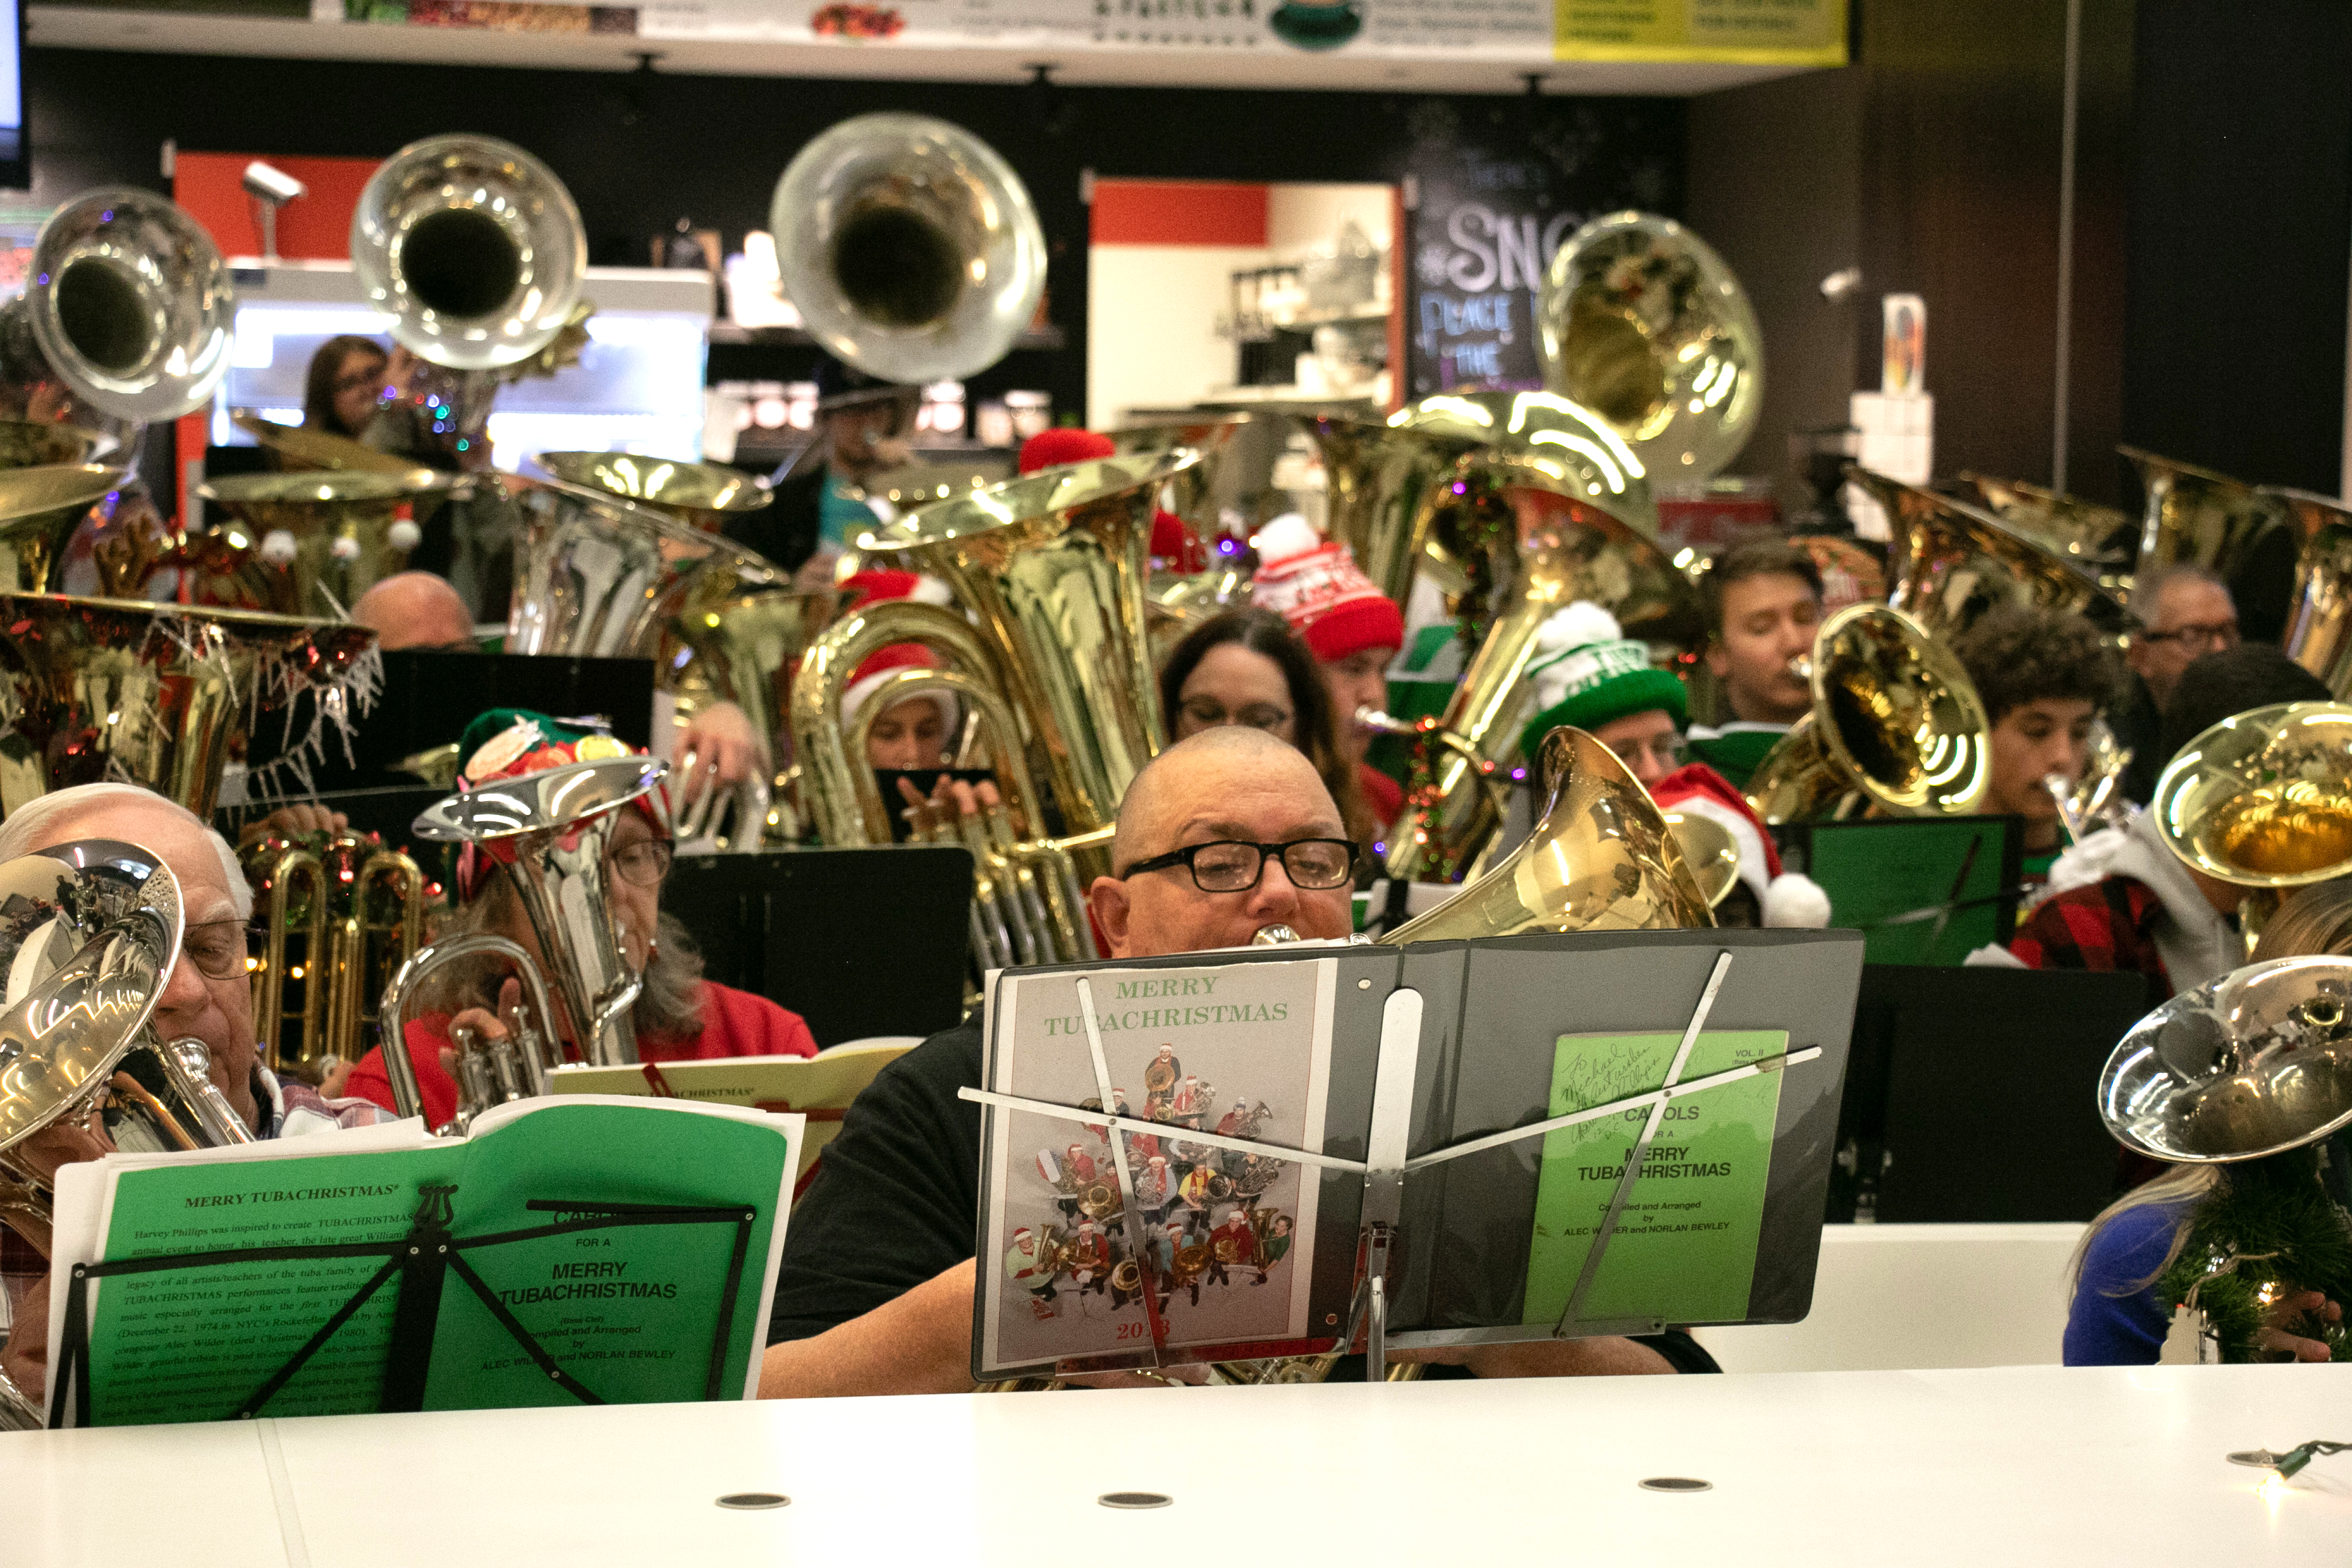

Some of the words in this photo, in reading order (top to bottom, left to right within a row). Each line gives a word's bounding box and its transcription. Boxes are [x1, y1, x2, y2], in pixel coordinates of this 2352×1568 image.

[1115, 976, 1220, 999] MERRY
[1735, 1049, 1755, 1057] VOL.
[1624, 1106, 1700, 1122] CAOLS
[1577, 1162, 1732, 1182] TUBAHRISTMAS
[183, 1193, 247, 1209] MERRY
[1598, 1202, 1640, 1212] Coiled
[1642, 1202, 1659, 1210] and
[1661, 1201, 1702, 1210] Arranged
[1643, 1214, 1654, 1222] by
[135, 1230, 170, 1240] Harvey
[173, 1226, 209, 1238] Phillips
[232, 1221, 269, 1234] inspired
[272, 1221, 281, 1230] to
[283, 1221, 313, 1230] create
[1563, 1227, 1589, 1236] ALEC
[1630, 1225, 1647, 1234] and
[1648, 1224, 1688, 1233] NORLAN
[1691, 1221, 1731, 1231] BEWLEY
[132, 1245, 163, 1255] annual
[166, 1245, 192, 1253] event
[195, 1244, 205, 1252] to
[207, 1242, 235, 1250] honor
[242, 1240, 256, 1248] his
[262, 1238, 299, 1246] teacher,
[301, 1236, 316, 1244] the
[319, 1235, 337, 1244] late
[339, 1234, 363, 1244] great
[366, 1232, 402, 1241] William
[575, 1238, 599, 1248] FOR
[602, 1238, 611, 1246] A
[127, 1280, 156, 1291] legacy
[160, 1277, 172, 1287] of
[175, 1276, 189, 1285] all
[266, 1270, 279, 1279] of
[281, 1270, 296, 1278] the
[300, 1268, 322, 1277] tuba
[326, 1266, 355, 1276] family
[360, 1264, 371, 1273] of
[551, 1261, 628, 1280] MERRY
[124, 1291, 222, 1306] TUBACHRISTMAS
[227, 1287, 291, 1300] performances
[297, 1284, 329, 1294] feature
[331, 1281, 367, 1291] traditio
[498, 1281, 677, 1306] TUBACHRISTMAS
[120, 1313, 147, 1322] music
[155, 1308, 203, 1320] especially
[210, 1304, 252, 1315] arranged
[259, 1303, 273, 1312] for
[280, 1302, 294, 1311] the
[300, 1299, 321, 1310] first
[117, 1327, 170, 1340] (December
[195, 1322, 219, 1331] 1974
[221, 1322, 230, 1330] in
[236, 1319, 270, 1329] NYC's
[361, 1313, 372, 1322] by
[528, 1328, 569, 1343] ompiled
[571, 1326, 591, 1336] and
[593, 1325, 642, 1337] Arranged
[115, 1344, 159, 1355] composer
[164, 1340, 187, 1349] Alec
[193, 1339, 225, 1347] Wilder
[260, 1333, 308, 1343] Christmas
[324, 1346, 344, 1354] who
[345, 1344, 367, 1353] have
[572, 1339, 585, 1349] by
[481, 1359, 510, 1371] ALEC
[556, 1353, 577, 1362] and
[578, 1350, 625, 1361] NORLAN
[628, 1350, 676, 1360] BEWLEY
[301, 1379, 331, 1389] gather
[332, 1378, 342, 1386] to
[343, 1378, 359, 1386] pay
